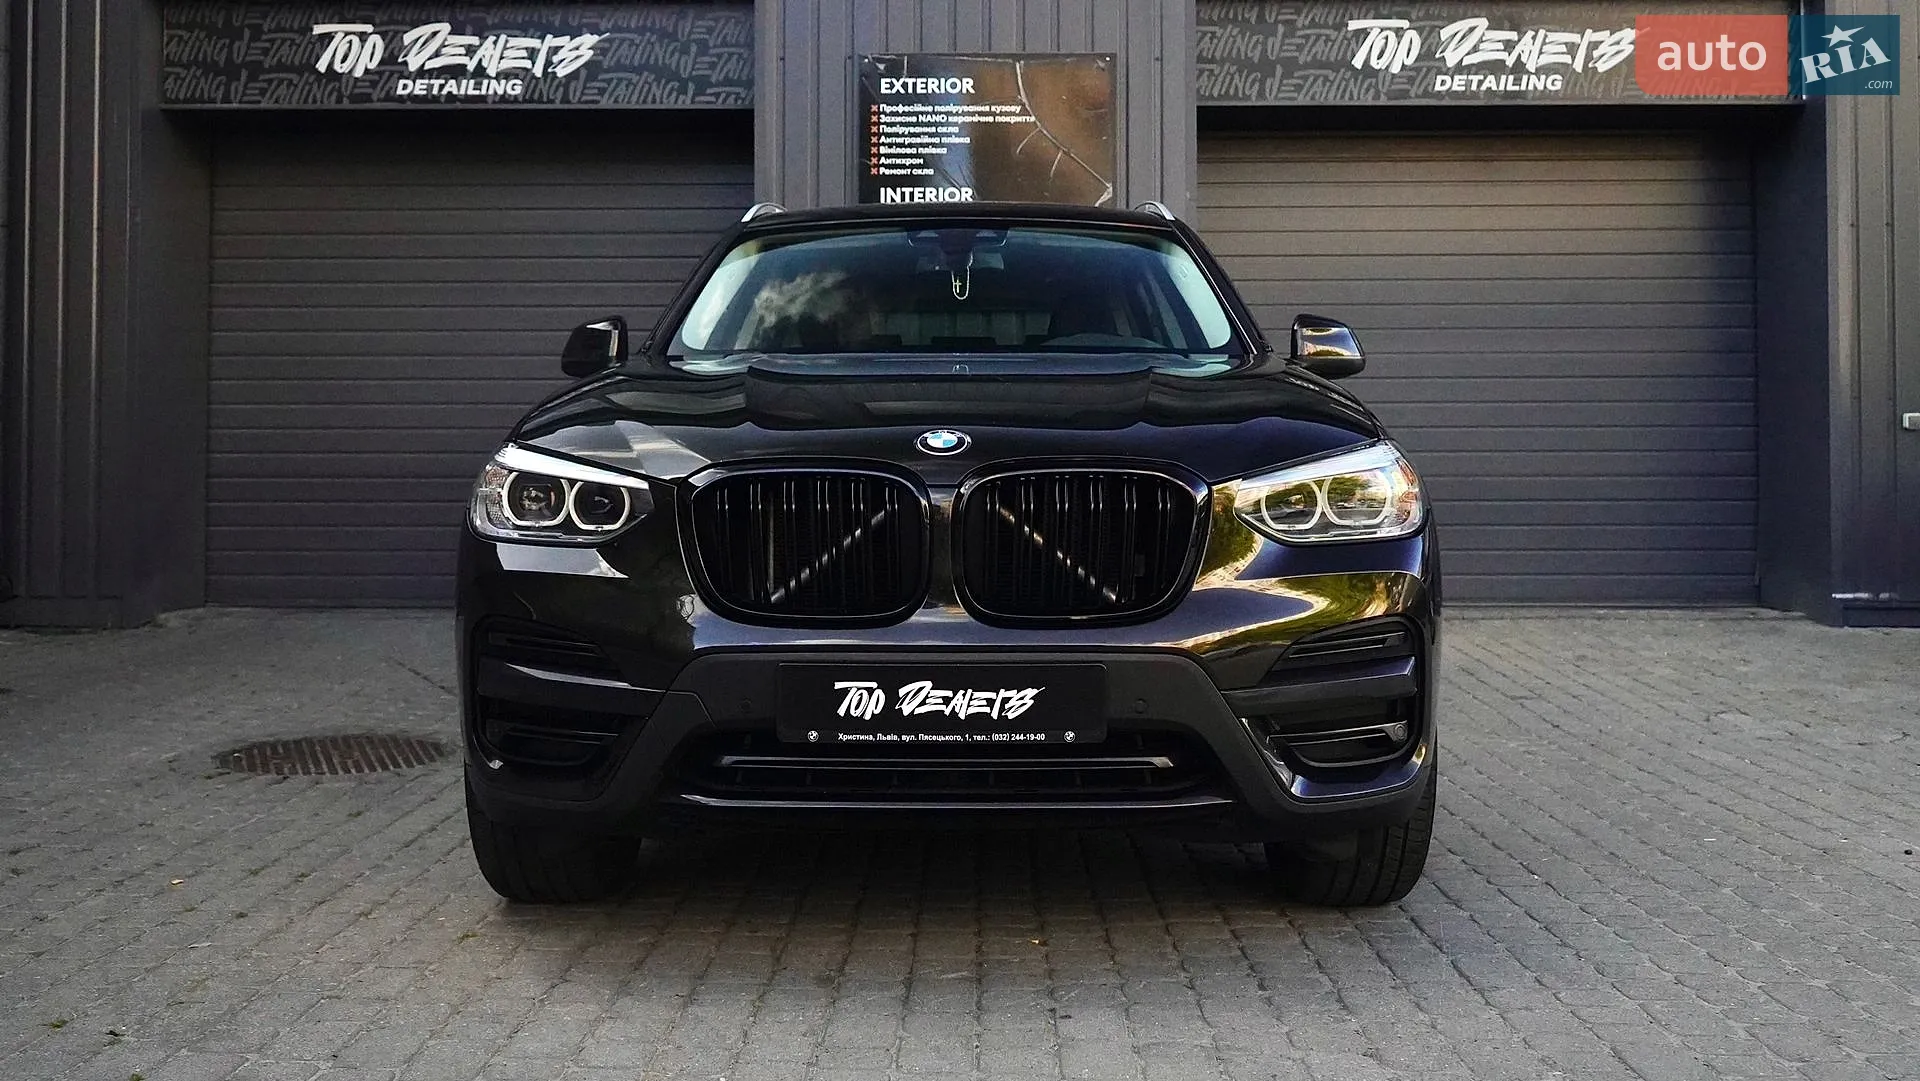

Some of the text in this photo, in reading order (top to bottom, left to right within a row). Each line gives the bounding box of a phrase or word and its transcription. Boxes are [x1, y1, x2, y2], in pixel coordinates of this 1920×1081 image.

[397, 79, 523, 96] DETAILING
[880, 77, 976, 94] EXTERIOR
[1434, 74, 1564, 92] DETAILING
[880, 103, 934, 114] Професійне
[934, 103, 990, 114] полірування
[880, 114, 917, 123] Захисне
[918, 114, 947, 122] NANO
[880, 124, 936, 135] Полірування
[941, 135, 971, 144] плівка
[880, 146, 948, 154] Вінілова плівка
[880, 156, 924, 166] Антихром
[880, 167, 912, 175] Ремонт
[880, 187, 973, 204] INTERIOR
[838, 732, 876, 742] Христина,
[876, 733, 900, 742] Львів,
[901, 735, 917, 743] вул.
[991, 733, 1010, 742] (032)
[1011, 733, 1046, 742] 244-19-00
